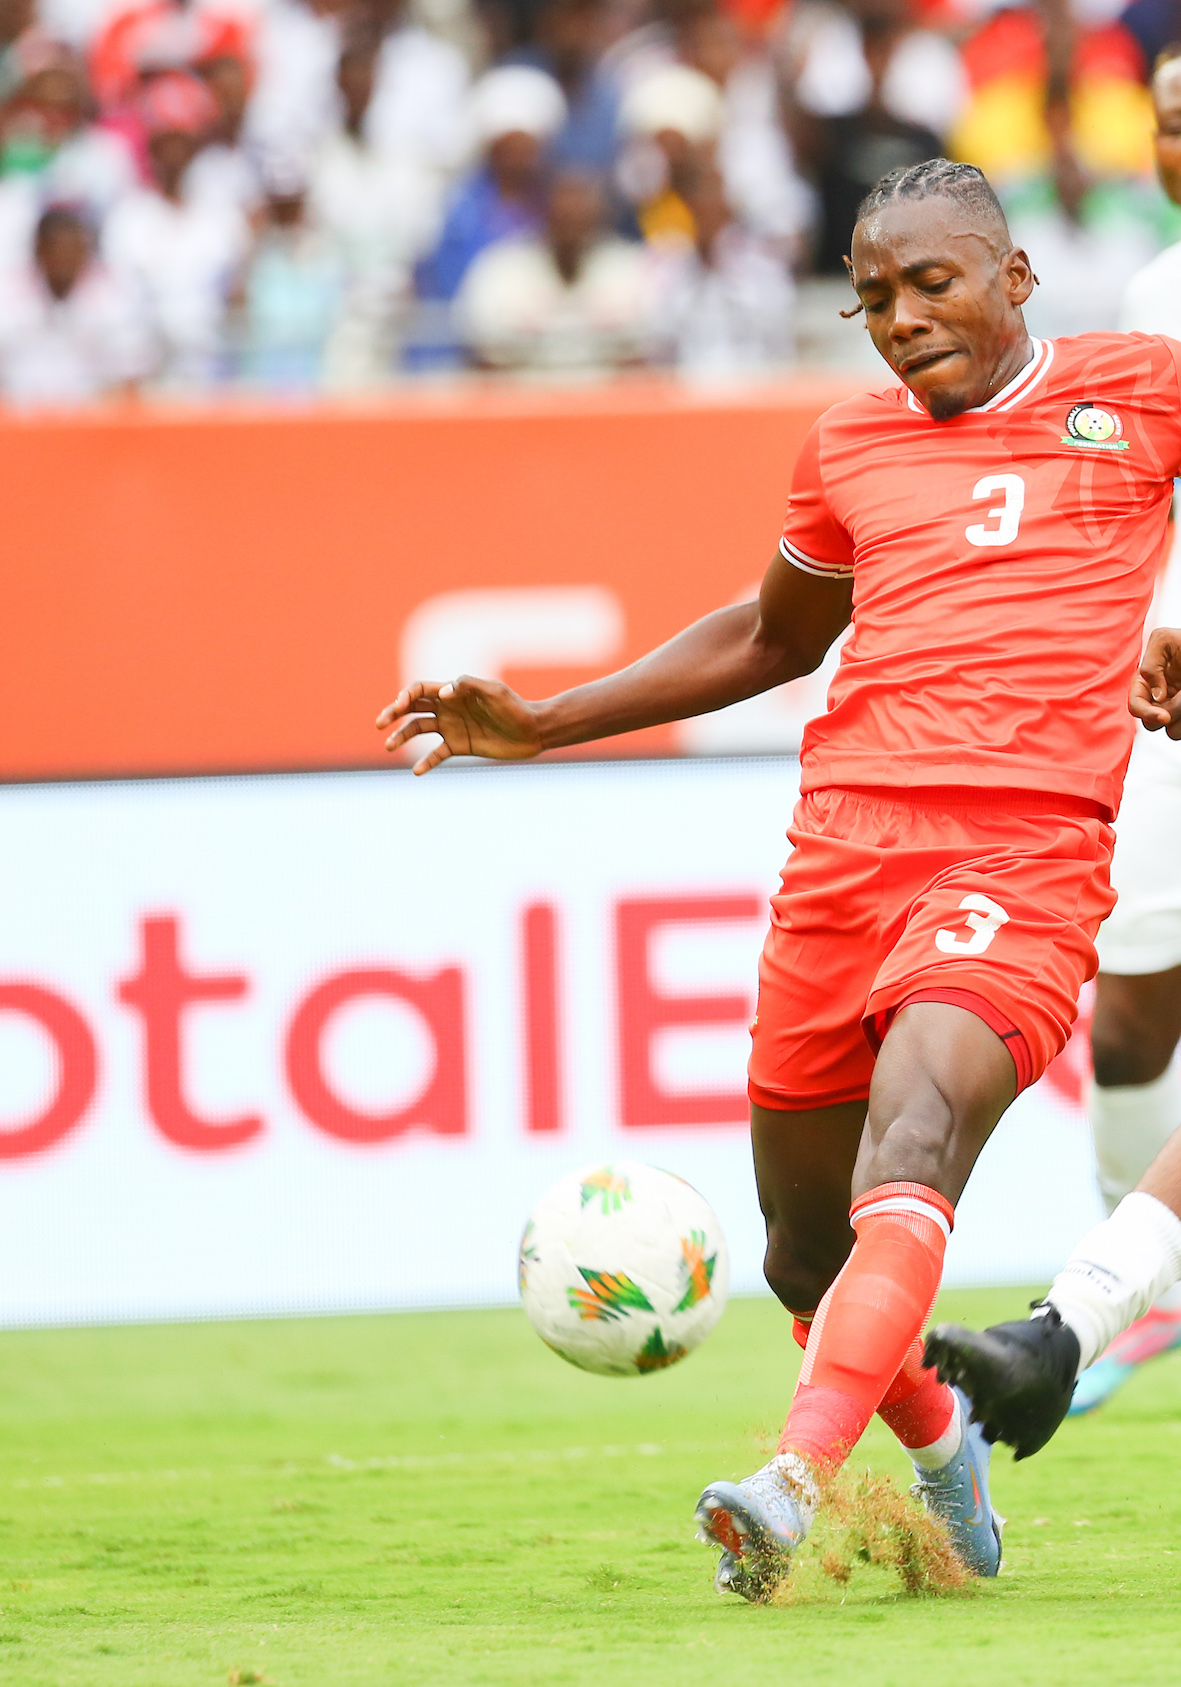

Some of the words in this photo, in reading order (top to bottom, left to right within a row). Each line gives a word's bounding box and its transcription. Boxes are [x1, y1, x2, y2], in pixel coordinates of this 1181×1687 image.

[1073, 440, 1119, 450] FEDERATION
[965, 473, 1025, 547] 3
[935, 893, 1011, 955] 3
